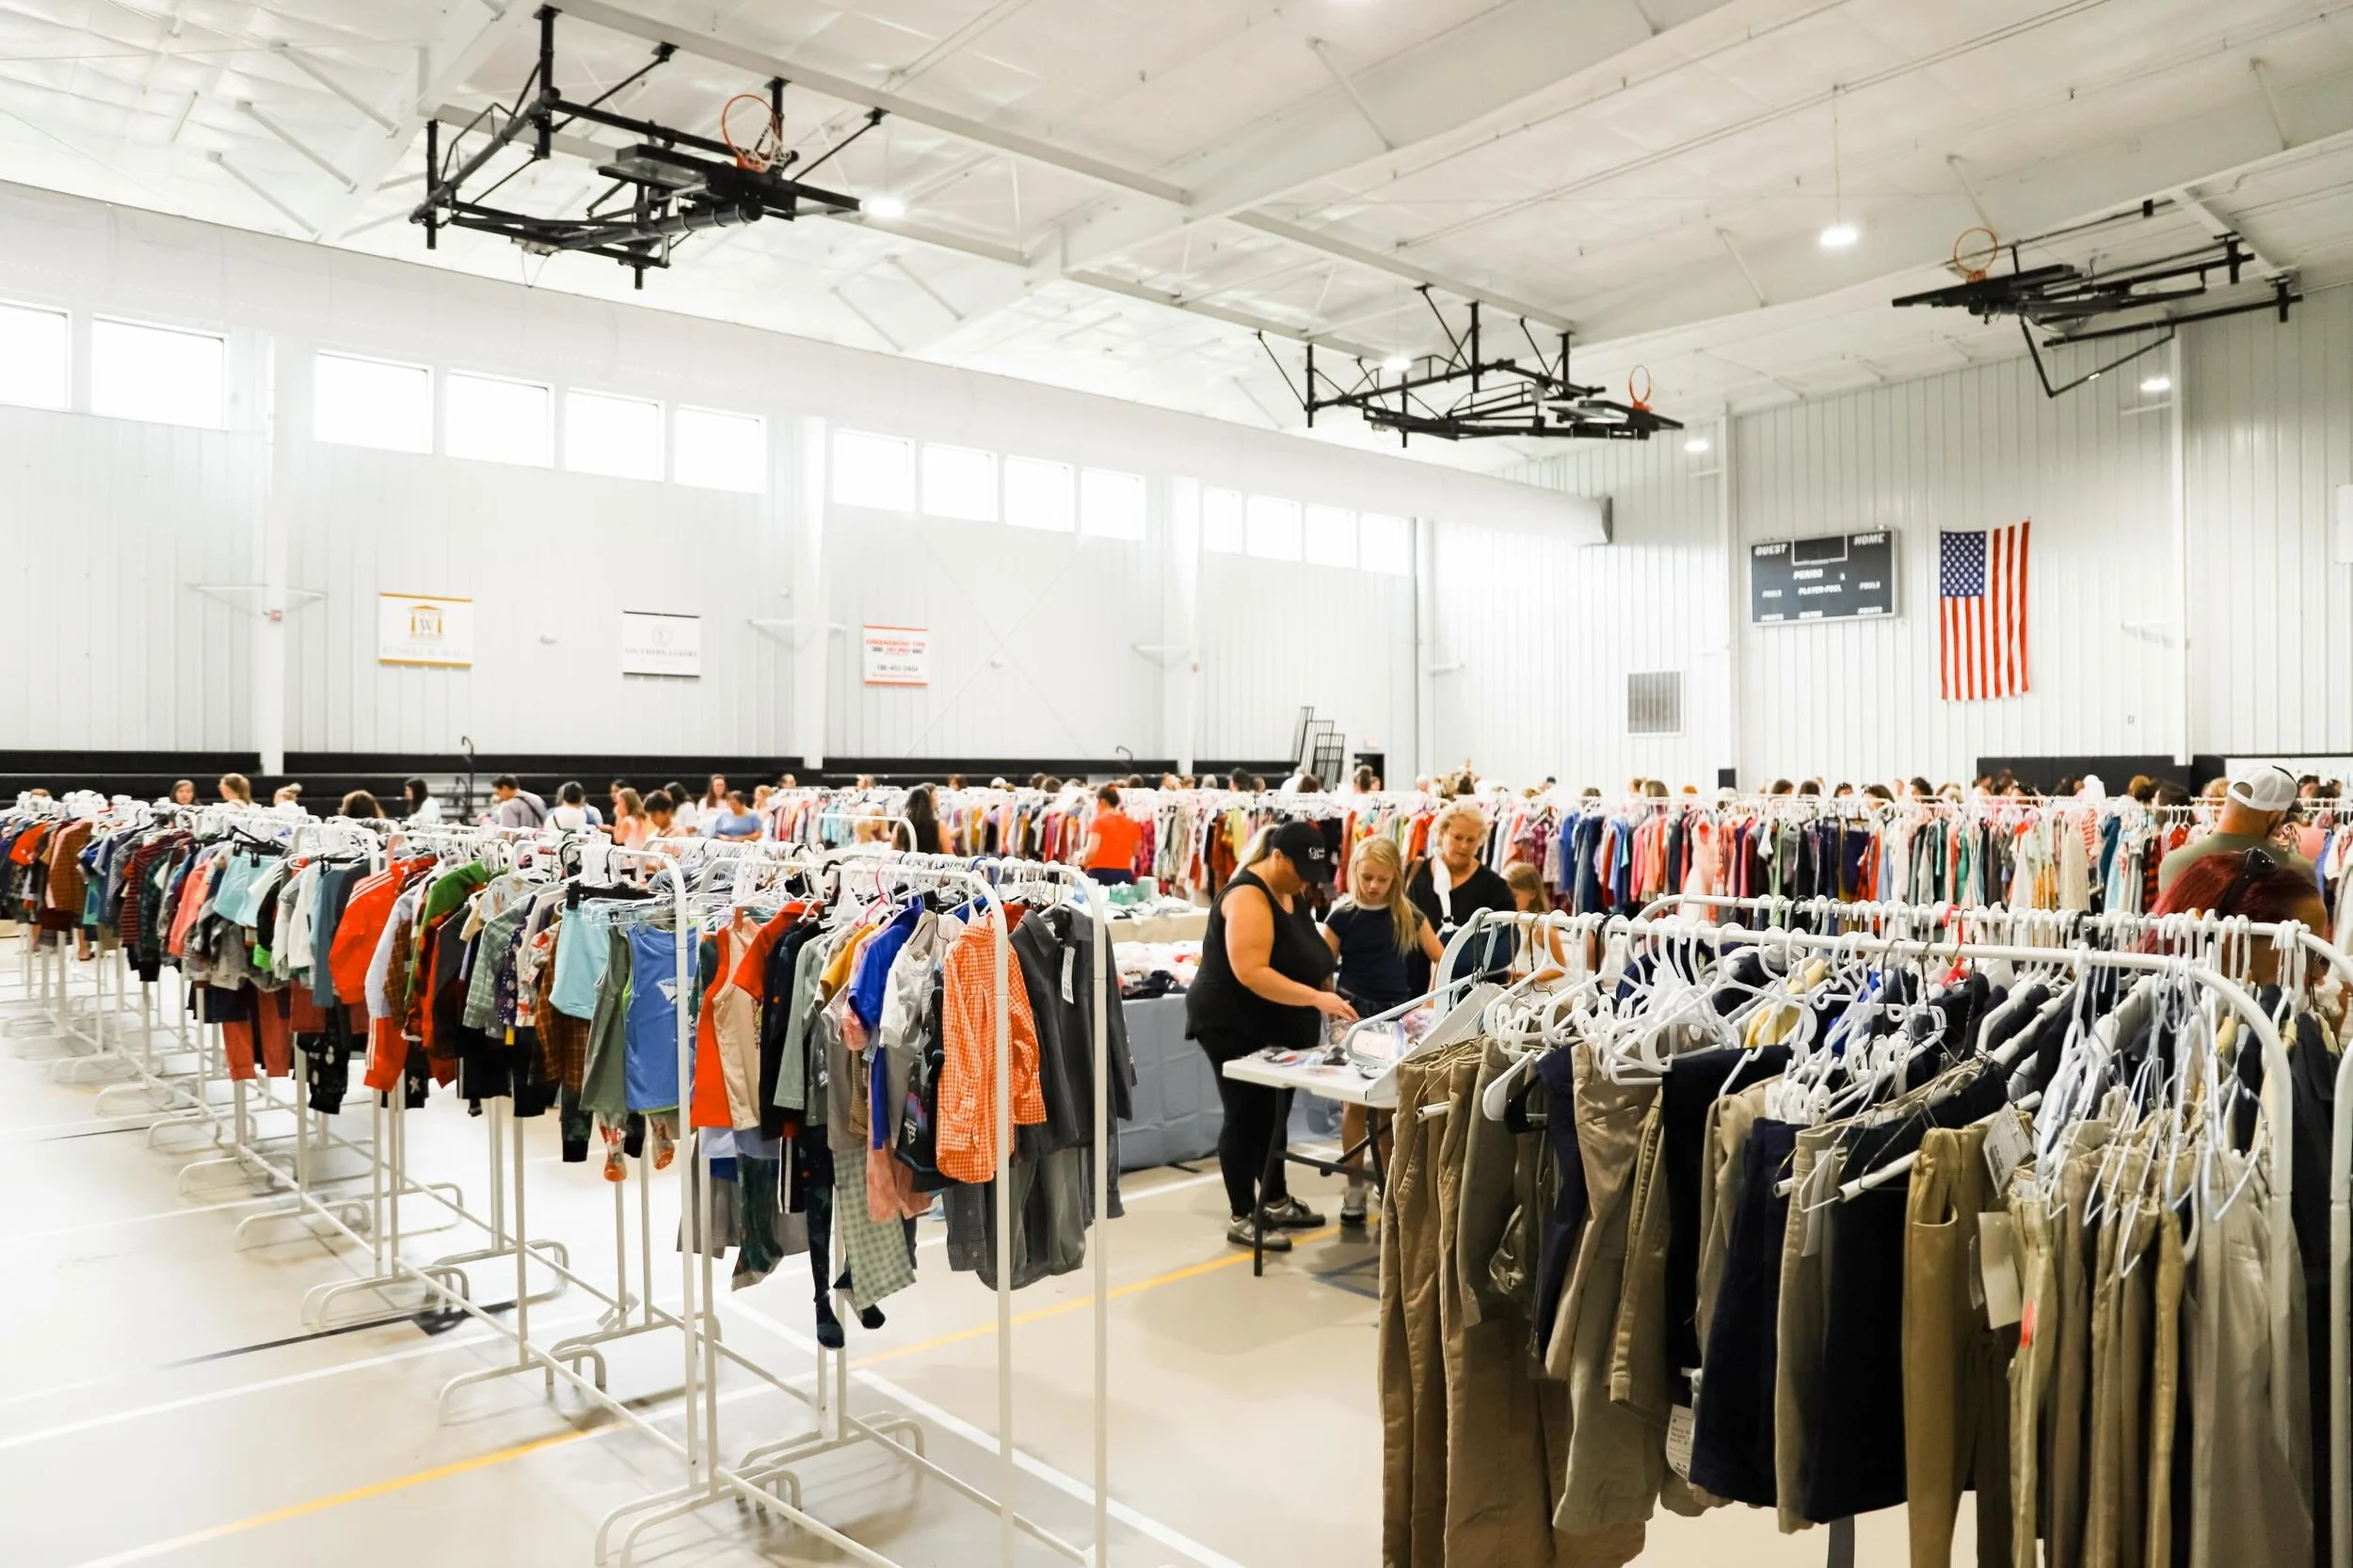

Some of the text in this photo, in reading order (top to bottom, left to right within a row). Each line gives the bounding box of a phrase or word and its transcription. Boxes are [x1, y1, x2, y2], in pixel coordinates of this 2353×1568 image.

[1853, 533, 1885, 546] HOME
[1754, 543, 1788, 557] GUEST
[1792, 568, 1823, 580] PERIOD
[1798, 584, 1842, 595] PLAYER-FOUL
